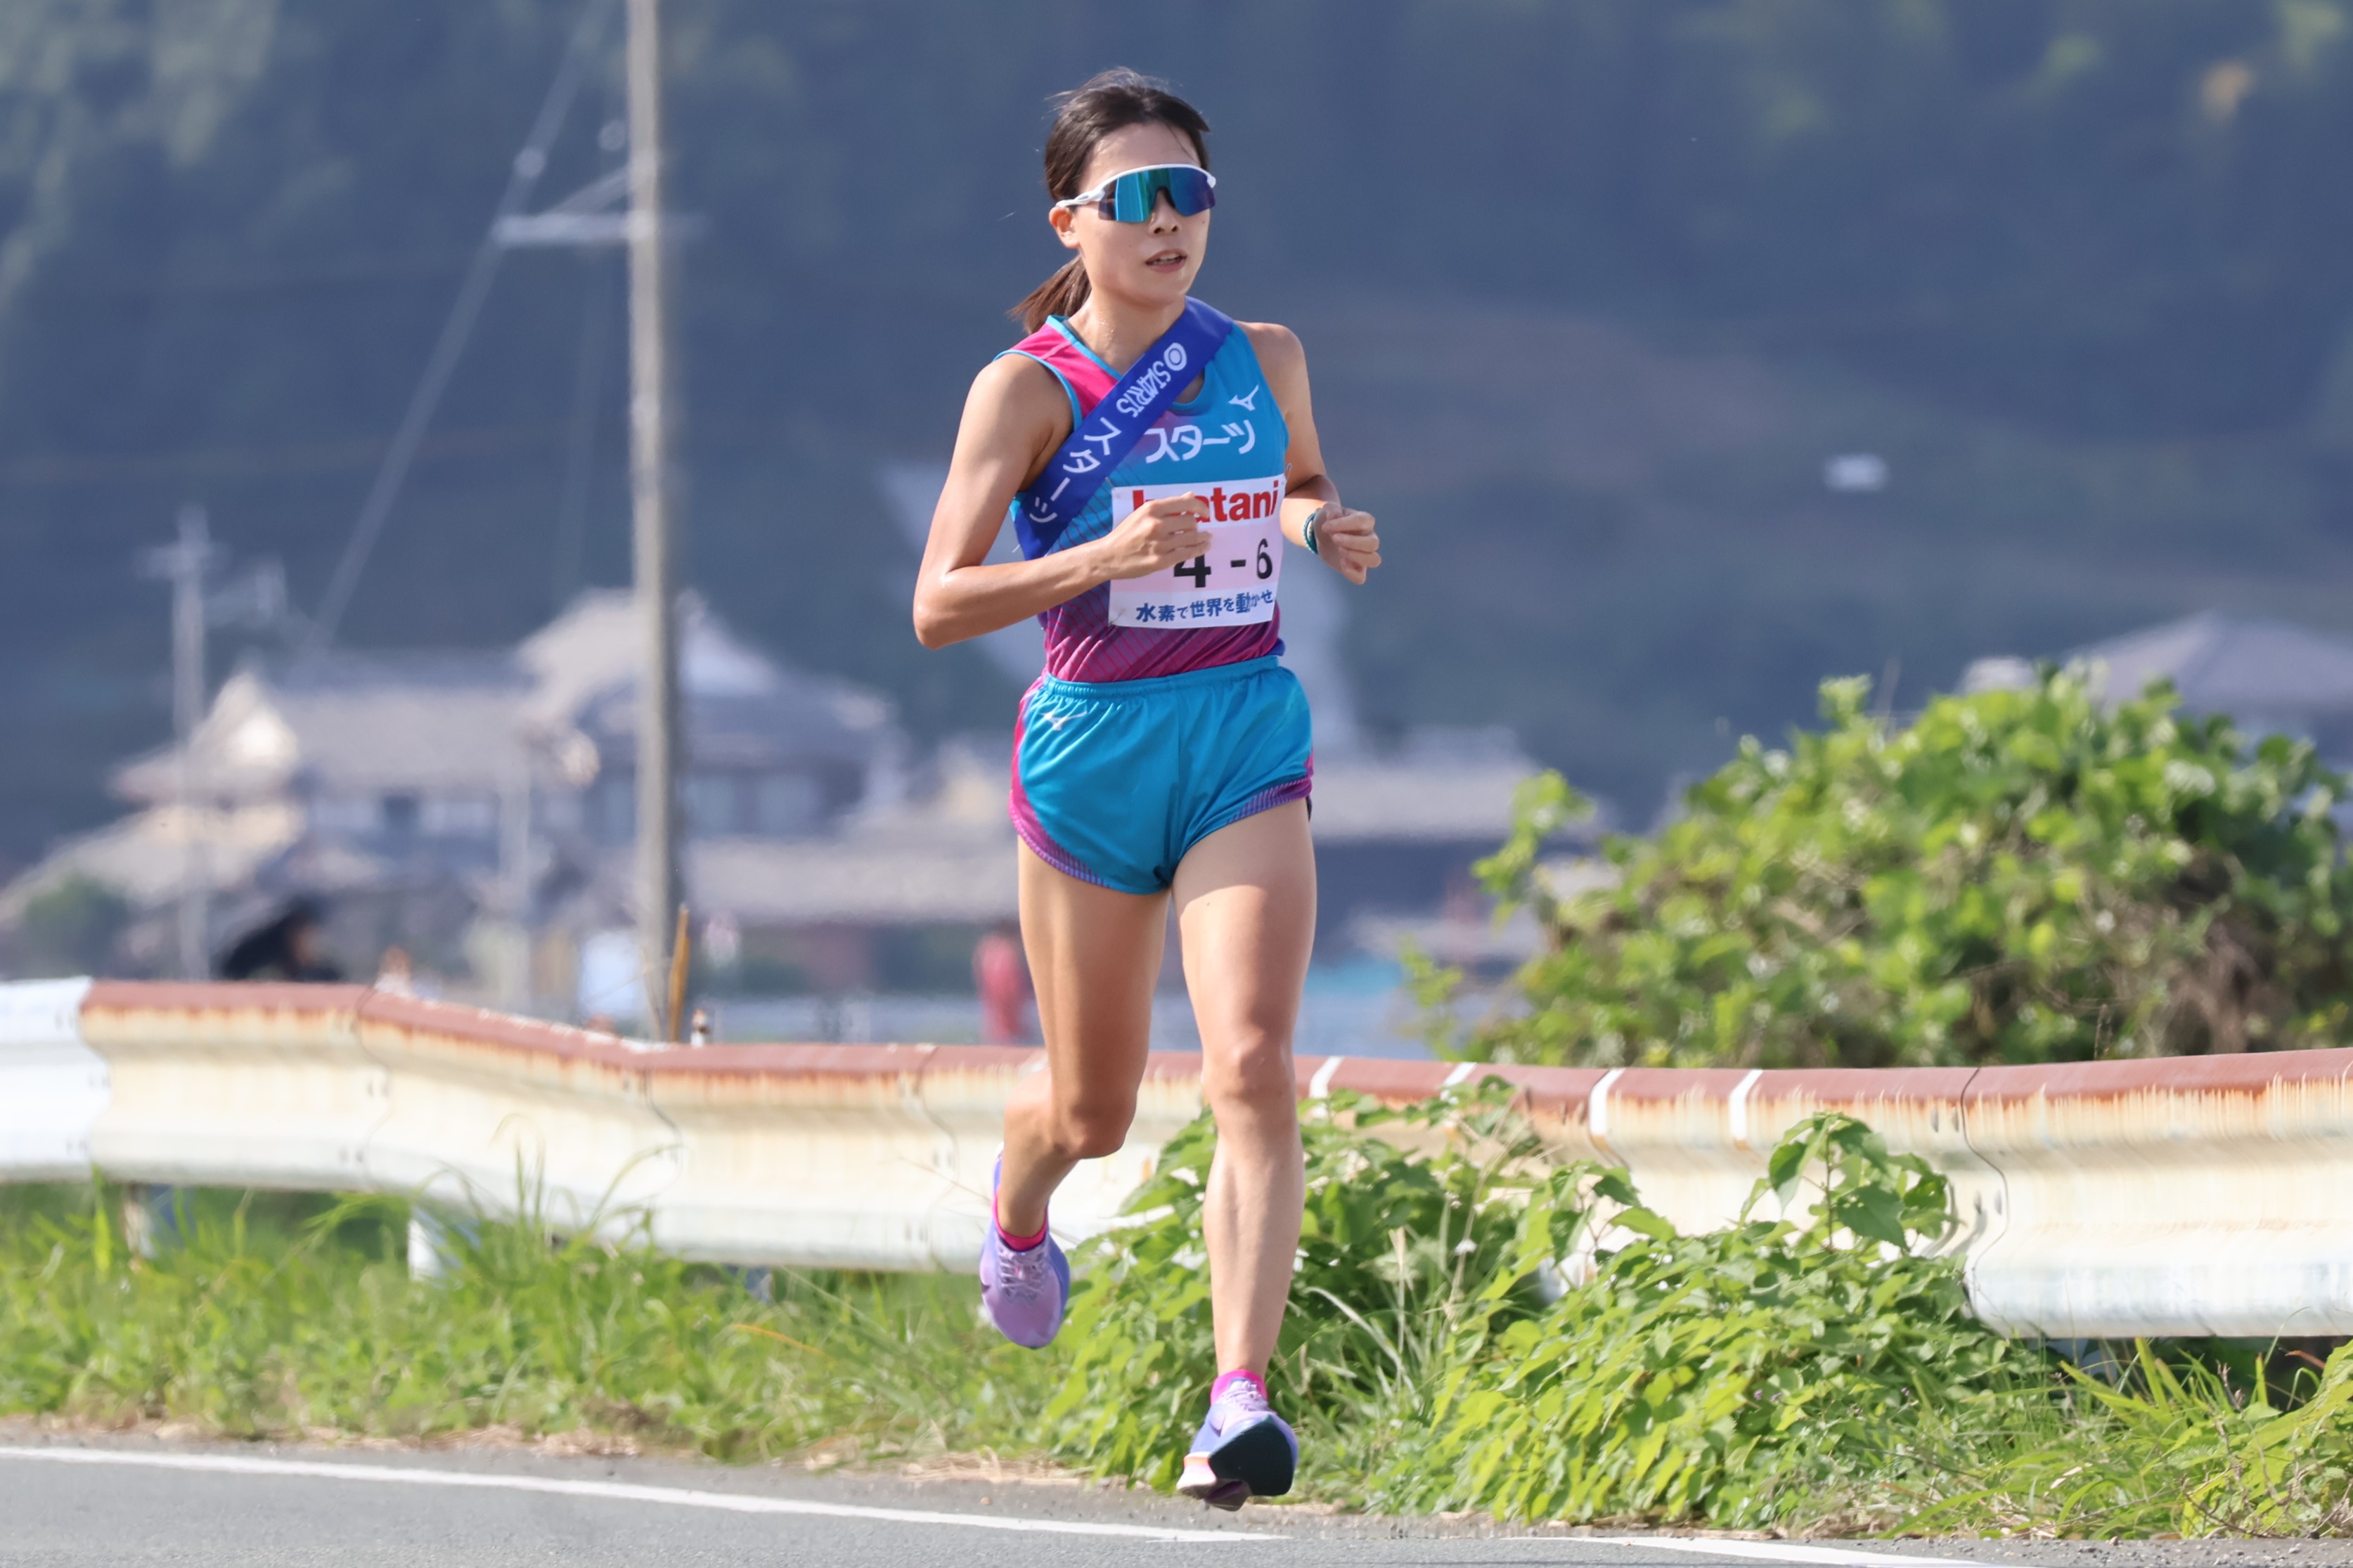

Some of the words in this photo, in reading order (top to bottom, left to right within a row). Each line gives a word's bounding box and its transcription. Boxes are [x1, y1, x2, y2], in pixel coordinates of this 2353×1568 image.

[1144, 420, 1256, 463] スターツ
[1029, 417, 1122, 523] スターツ
[1133, 480, 1279, 524] Itani
